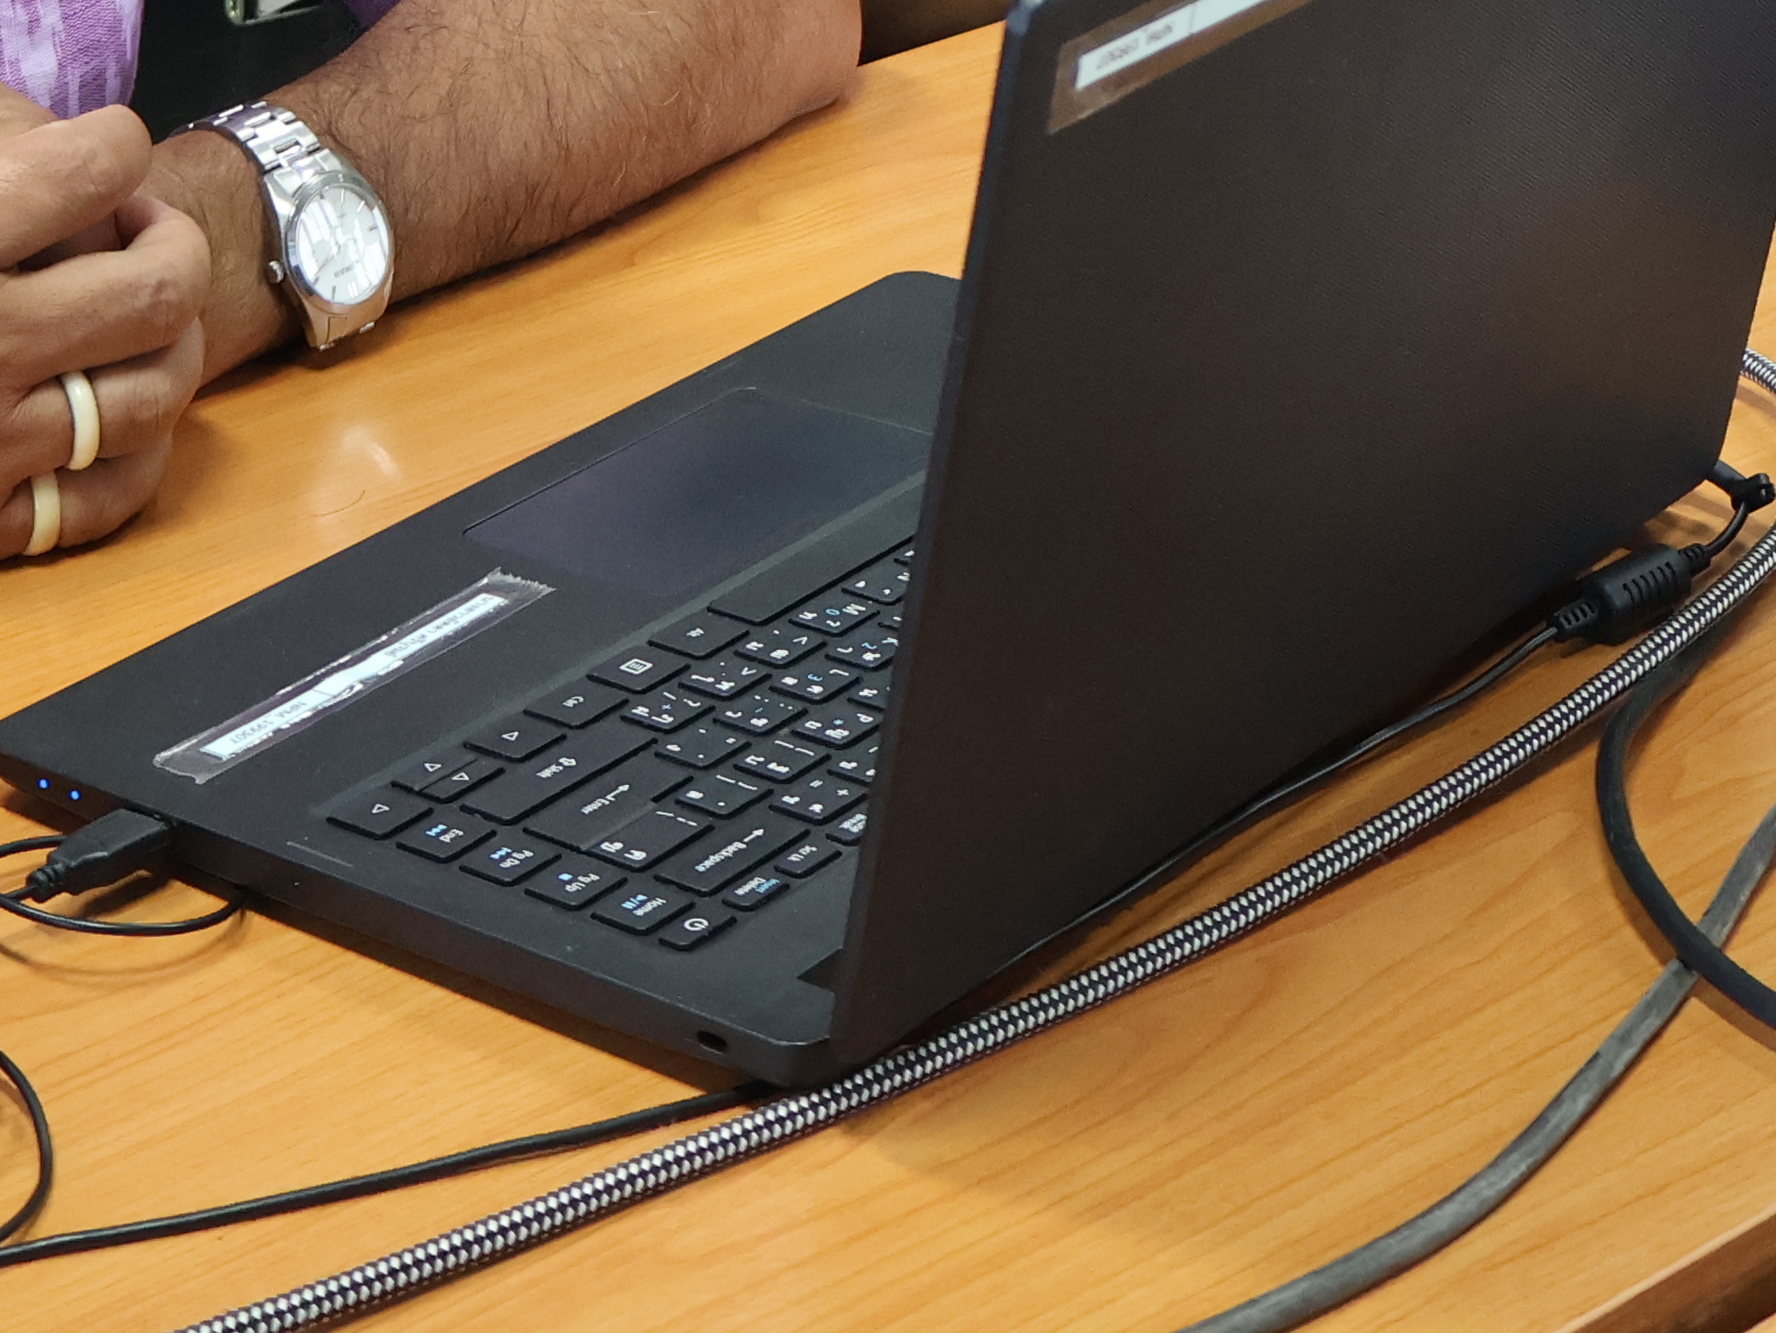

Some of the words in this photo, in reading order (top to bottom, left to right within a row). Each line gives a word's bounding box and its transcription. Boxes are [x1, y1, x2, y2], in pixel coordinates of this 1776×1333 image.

[580, 798, 610, 815] Enter
[438, 828, 465, 843] End
[694, 840, 748, 873] Backspace
[631, 897, 667, 917] Home
